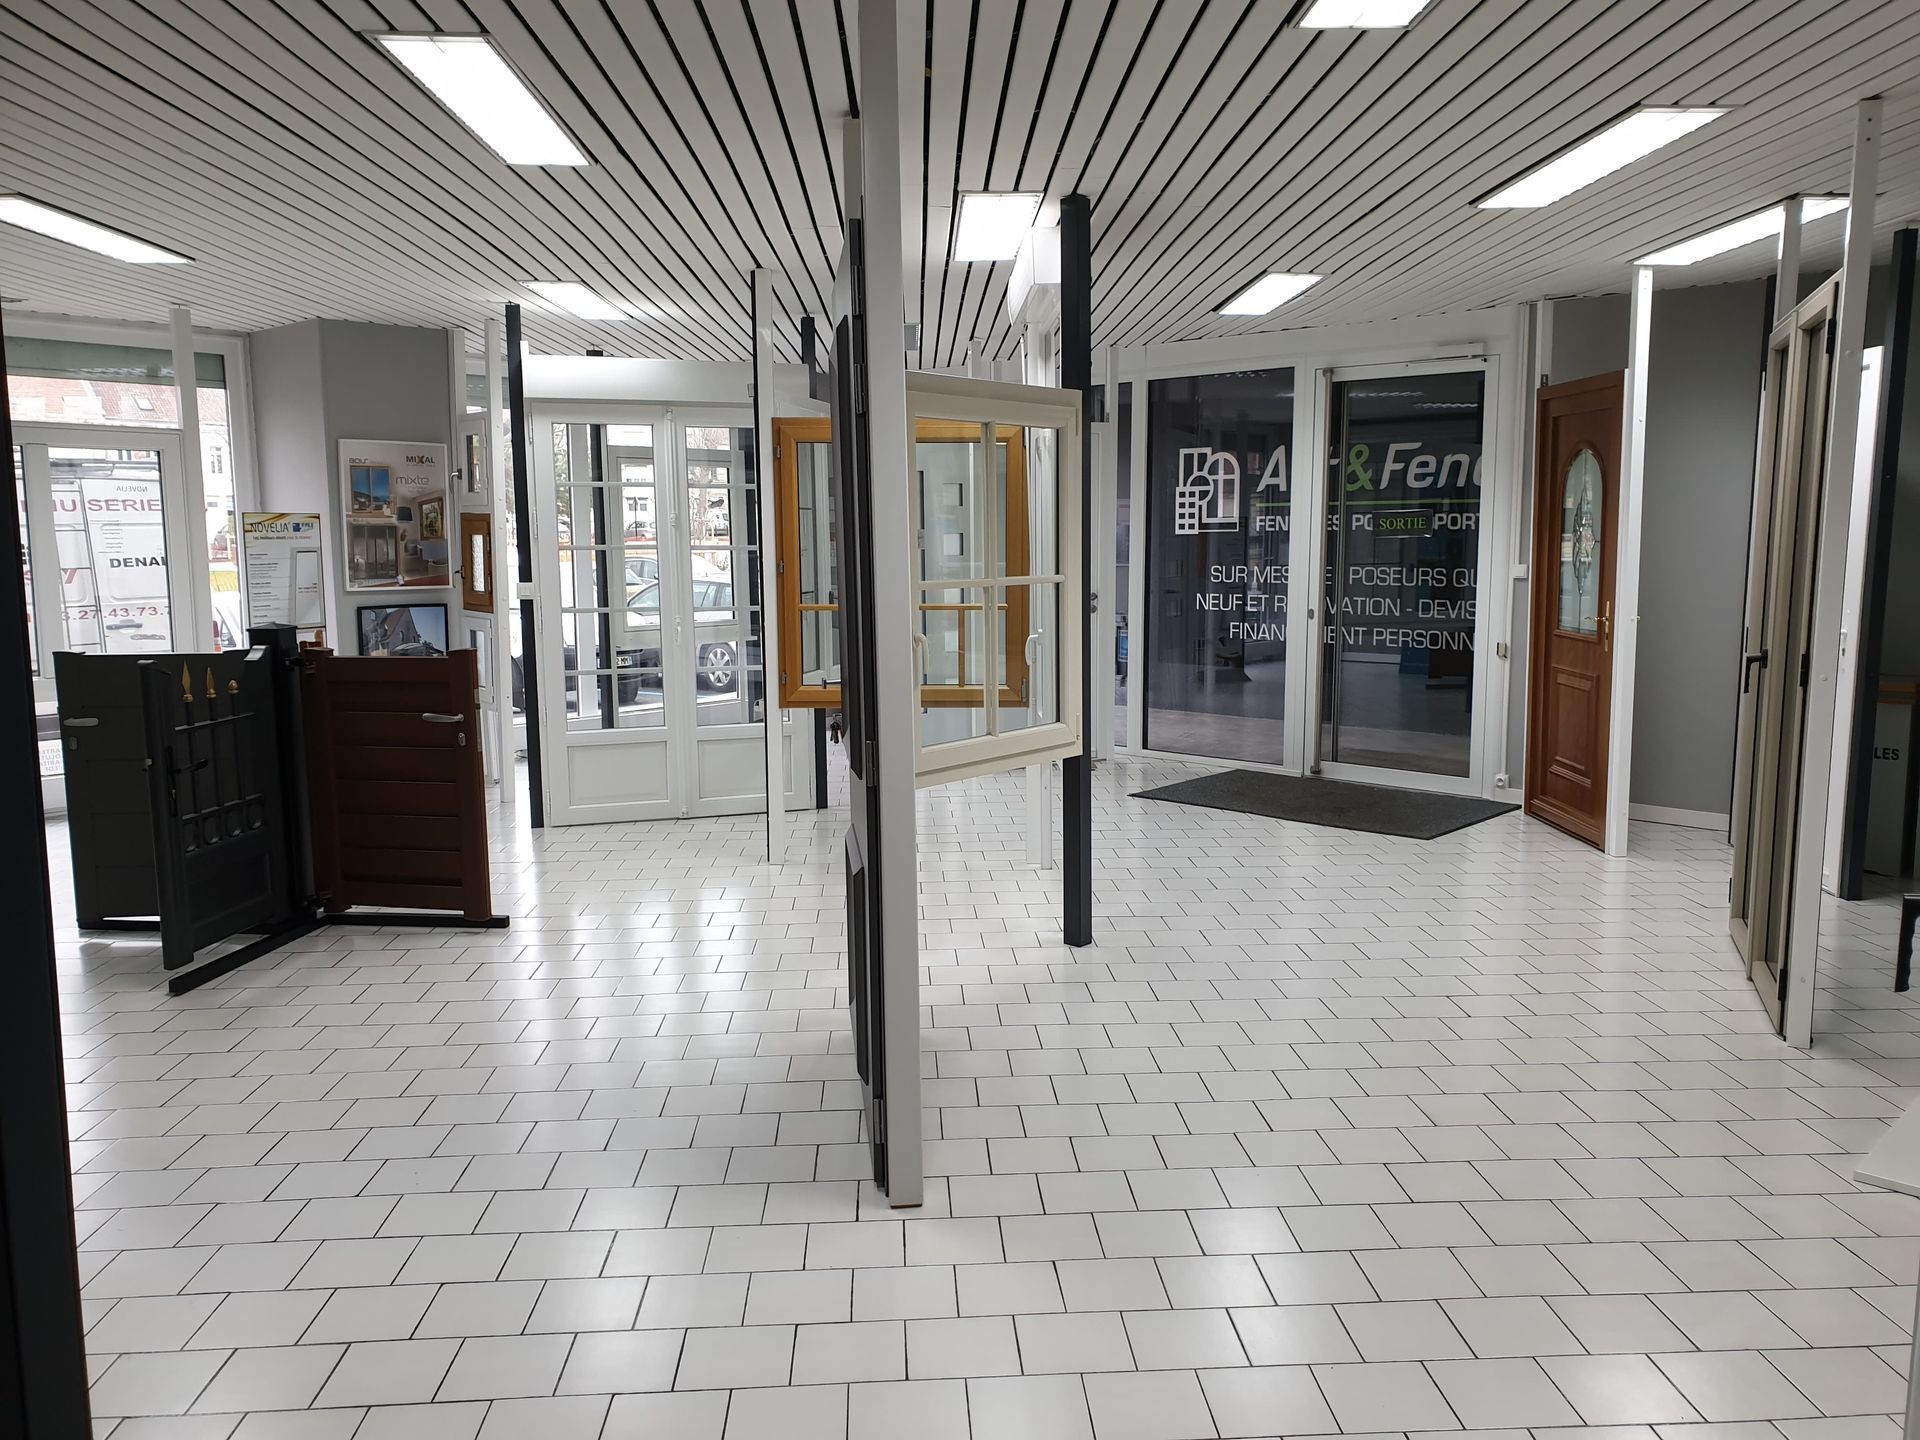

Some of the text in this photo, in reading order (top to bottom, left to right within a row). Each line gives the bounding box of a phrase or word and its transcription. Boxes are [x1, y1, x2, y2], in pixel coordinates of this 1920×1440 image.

[405, 455, 435, 465] MIXAL
[396, 475, 430, 486] mixte
[250, 522, 290, 533] NOVELIA
[1379, 517, 1427, 530] SORTIE
[1210, 565, 1248, 584] SUR
[1349, 566, 1447, 587] POSEURS
[1196, 593, 1243, 611] NEUF
[1247, 594, 1270, 612] ET
[1418, 599, 1477, 620] DEVIS
